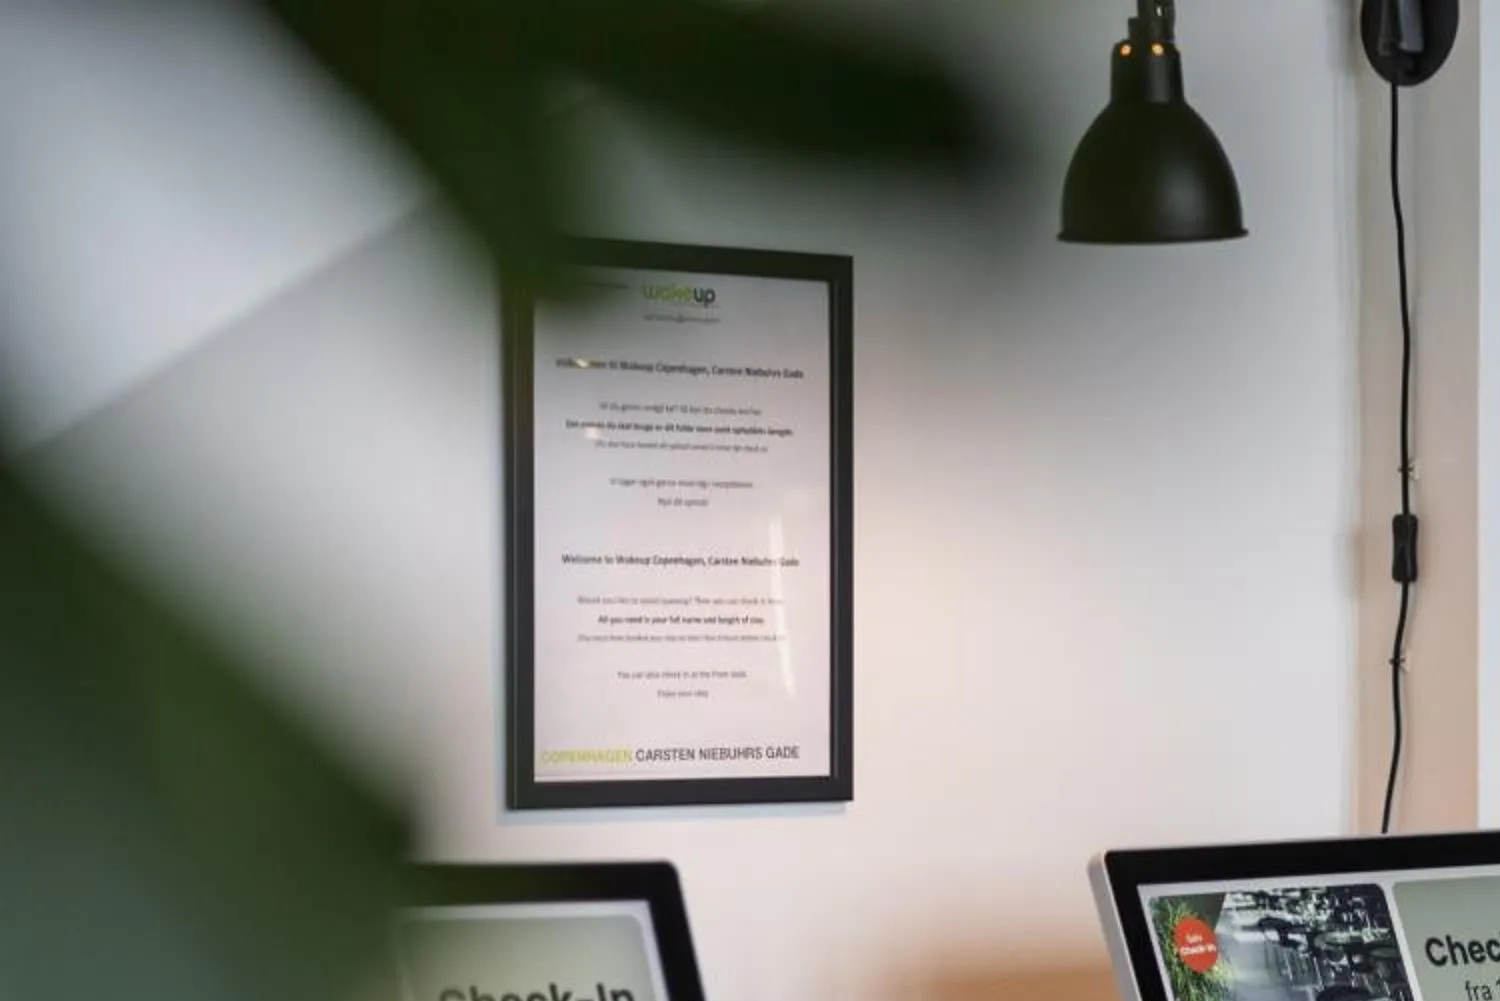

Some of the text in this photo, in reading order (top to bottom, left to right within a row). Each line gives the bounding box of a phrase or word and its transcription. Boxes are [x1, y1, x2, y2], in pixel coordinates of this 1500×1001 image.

[541, 745, 800, 764] COPENHAGEN CARSTEN NIEBUHRS GADE
